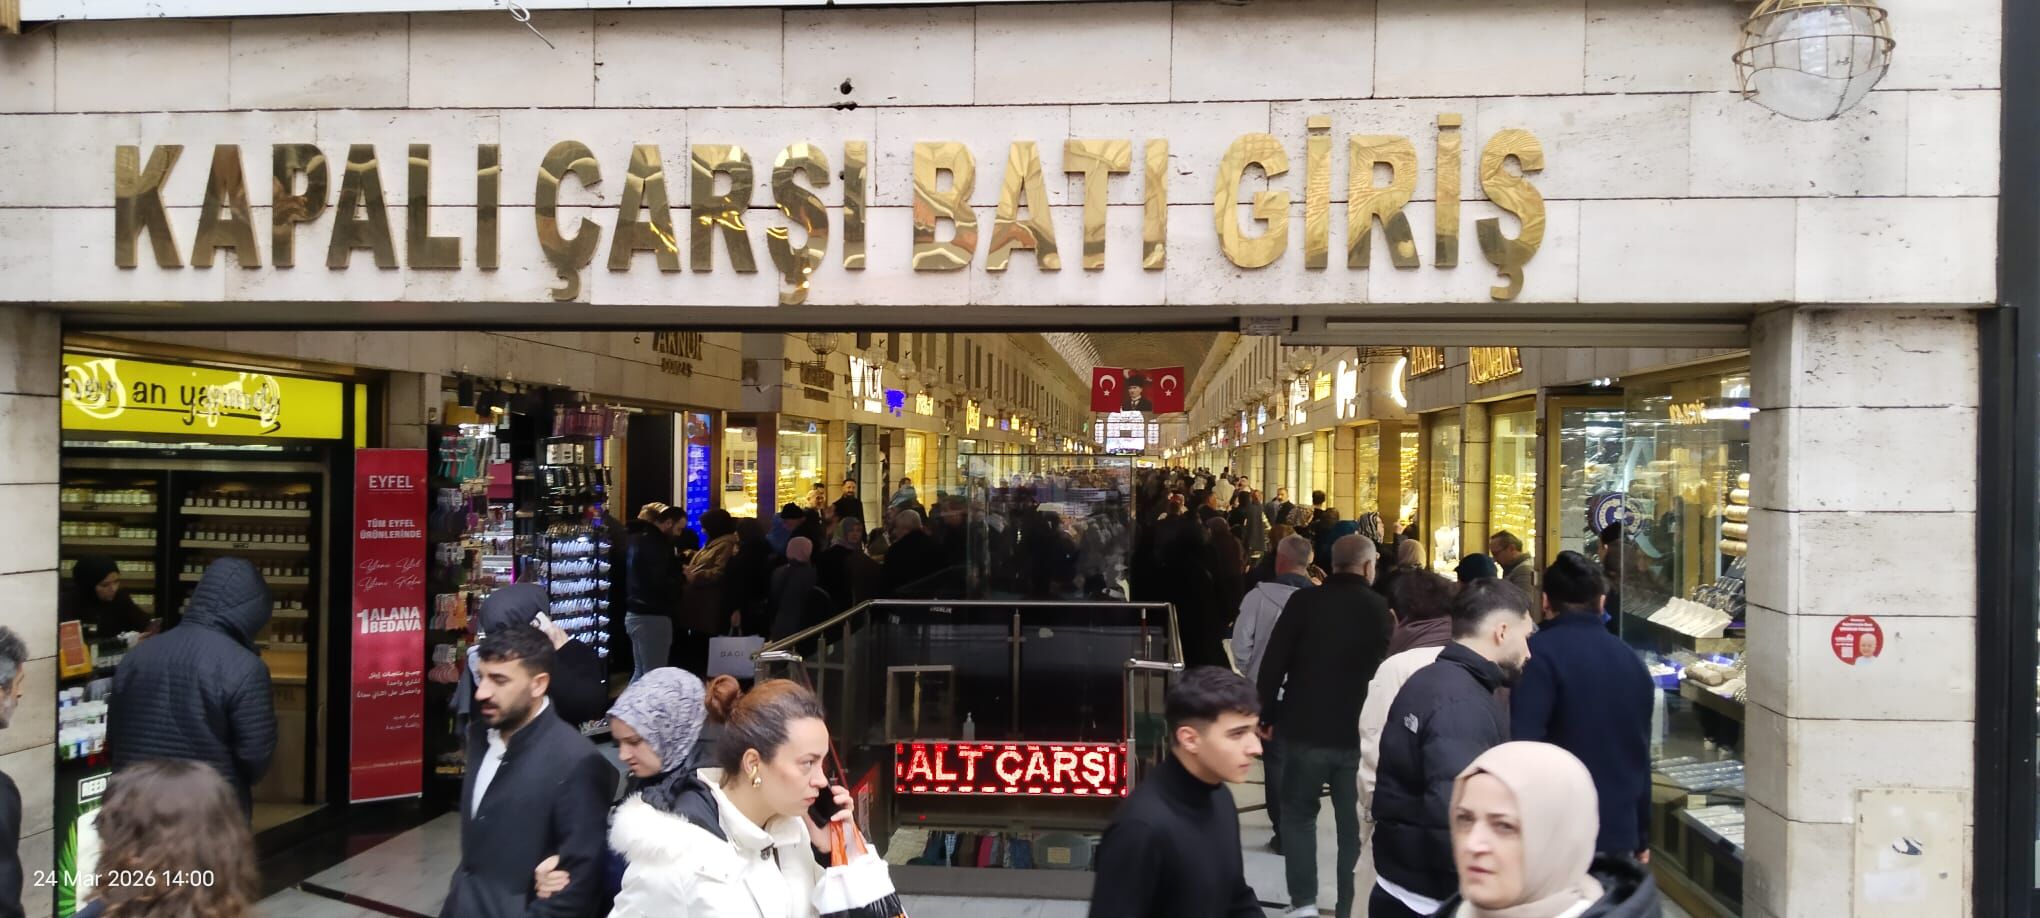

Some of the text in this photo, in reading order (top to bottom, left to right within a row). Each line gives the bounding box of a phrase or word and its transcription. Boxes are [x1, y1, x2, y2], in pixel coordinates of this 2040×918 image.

[115, 113, 1546, 305] KAPALI ÇARŞI BATI GİRİŞ
[133, 381, 166, 404] an
[368, 475, 414, 489] EYFEL
[366, 518, 415, 528] TÜM EYFEL
[359, 529, 421, 540] ÜRÜNLERİNDE
[357, 607, 420, 635] 1 ALANA
[369, 619, 422, 633] BEDAVA
[906, 749, 1116, 788] ALT ÇARŞI
